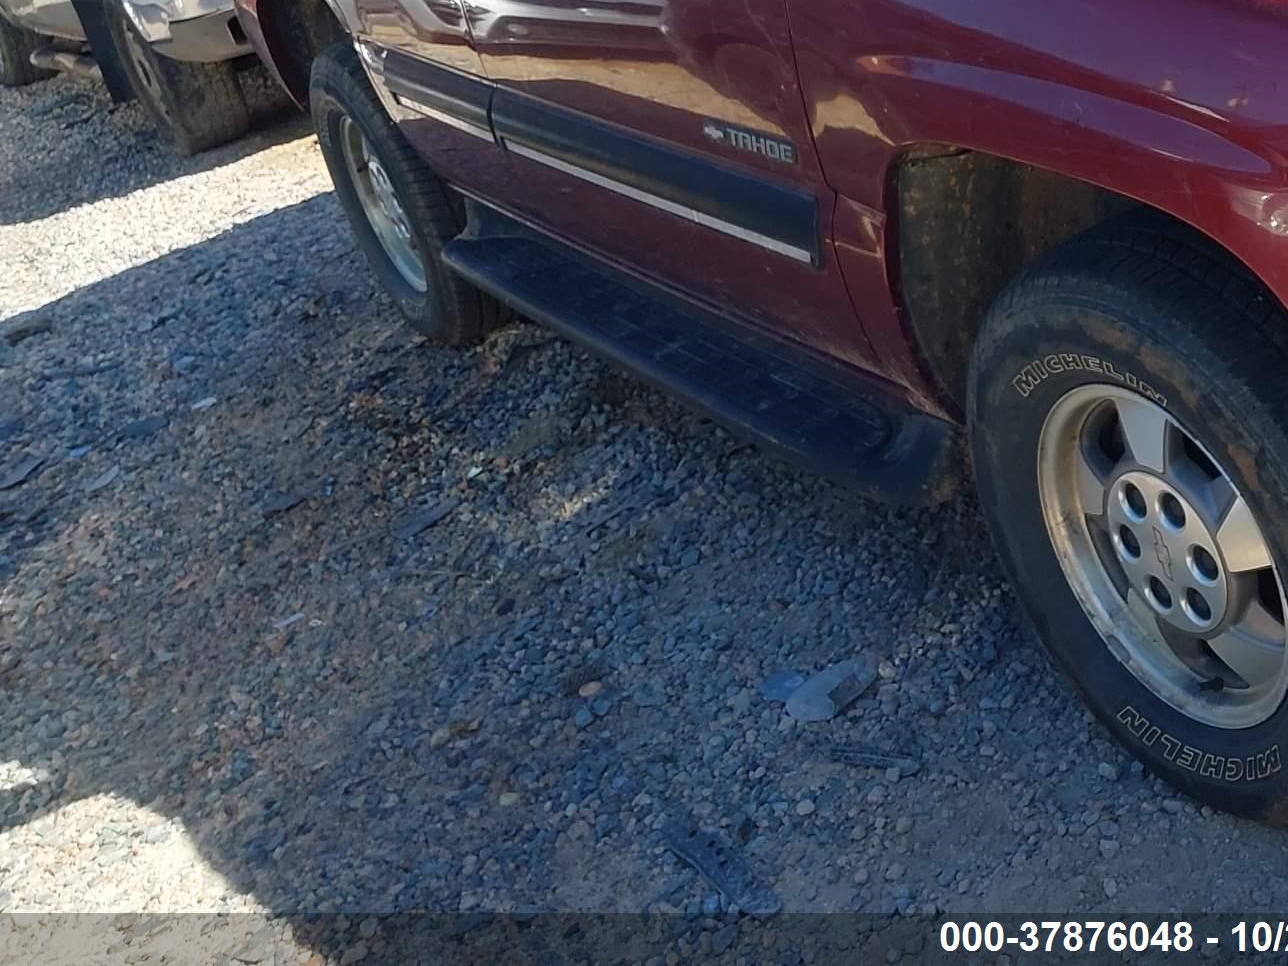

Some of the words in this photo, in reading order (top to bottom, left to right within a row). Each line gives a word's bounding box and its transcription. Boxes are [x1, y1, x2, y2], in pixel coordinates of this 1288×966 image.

[726, 128, 794, 162] TAHOE
[1012, 353, 1168, 407] MICHELIN
[1116, 705, 1282, 782] MICHELIN
